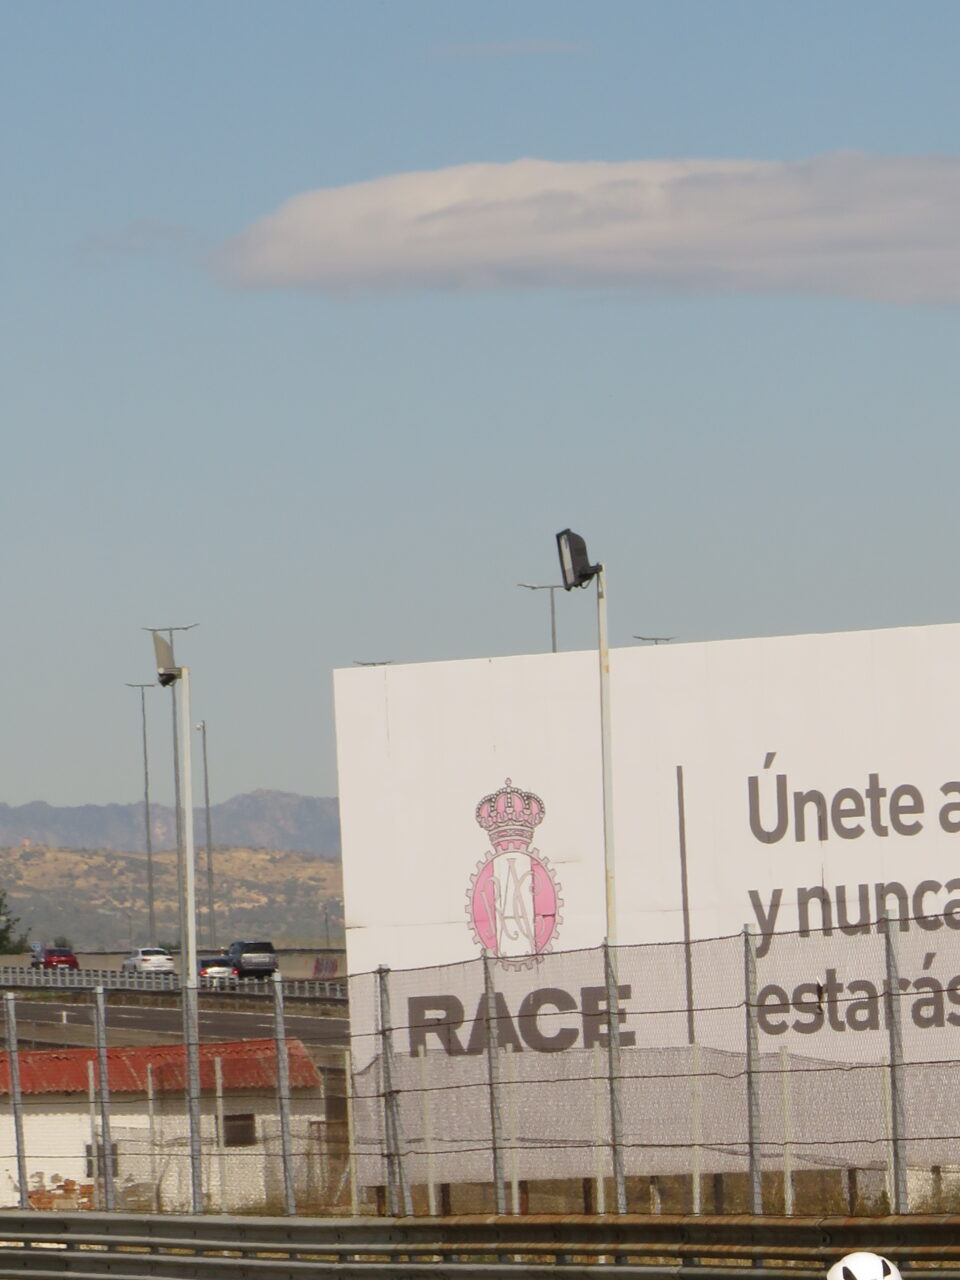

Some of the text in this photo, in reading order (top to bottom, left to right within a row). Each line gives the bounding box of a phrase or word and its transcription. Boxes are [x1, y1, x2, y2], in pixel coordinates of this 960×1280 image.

[747, 752, 925, 844] Únete
[748, 888, 783, 958] y
[408, 984, 637, 1057] RACE
